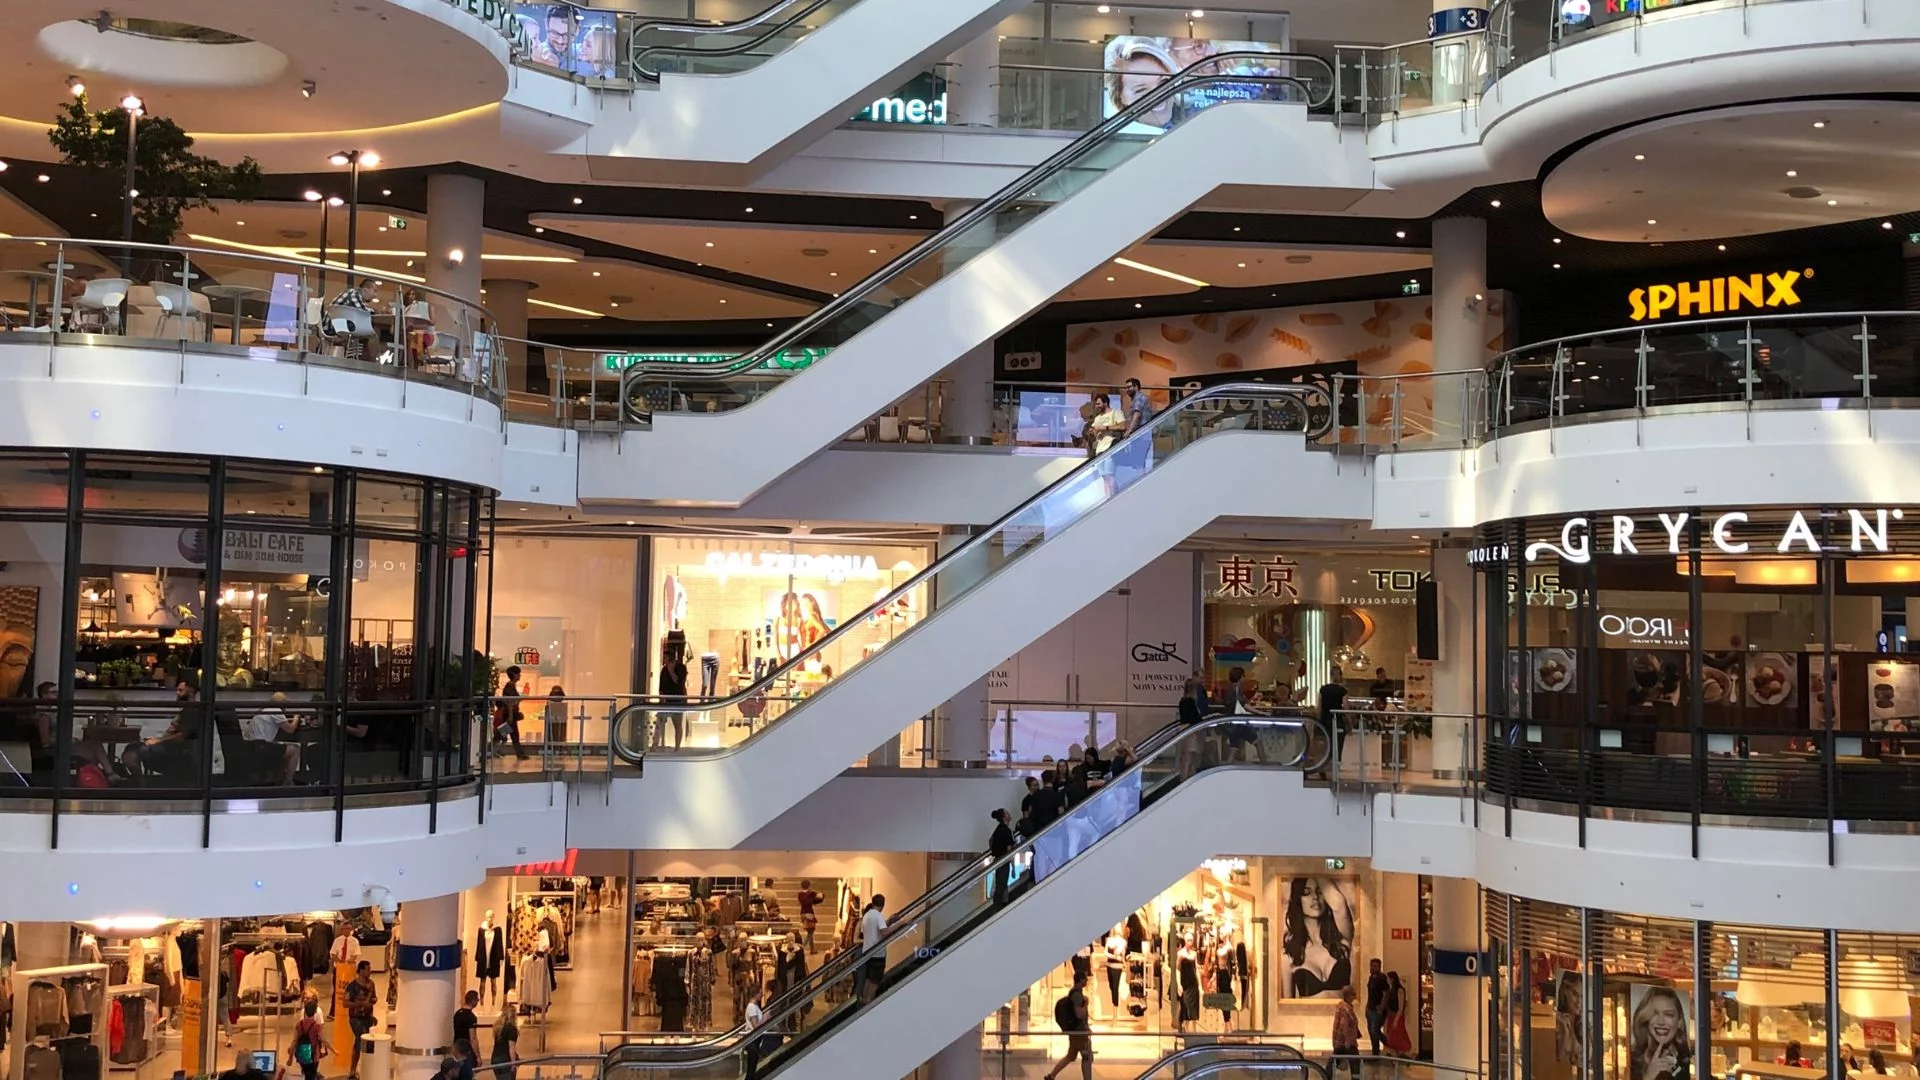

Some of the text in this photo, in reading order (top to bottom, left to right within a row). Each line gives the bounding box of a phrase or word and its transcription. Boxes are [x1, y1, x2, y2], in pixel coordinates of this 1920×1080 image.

[1206, 88, 1250, 99] najlepszą
[224, 531, 305, 552] BALI CAFE
[1525, 508, 1889, 564] GRYCAN
[1216, 554, 1299, 598] 東京
[515, 652, 540, 665] LIFE
[1132, 643, 1184, 664] Gatta
[422, 949, 436, 968] 0
[1465, 955, 1477, 973] 0
